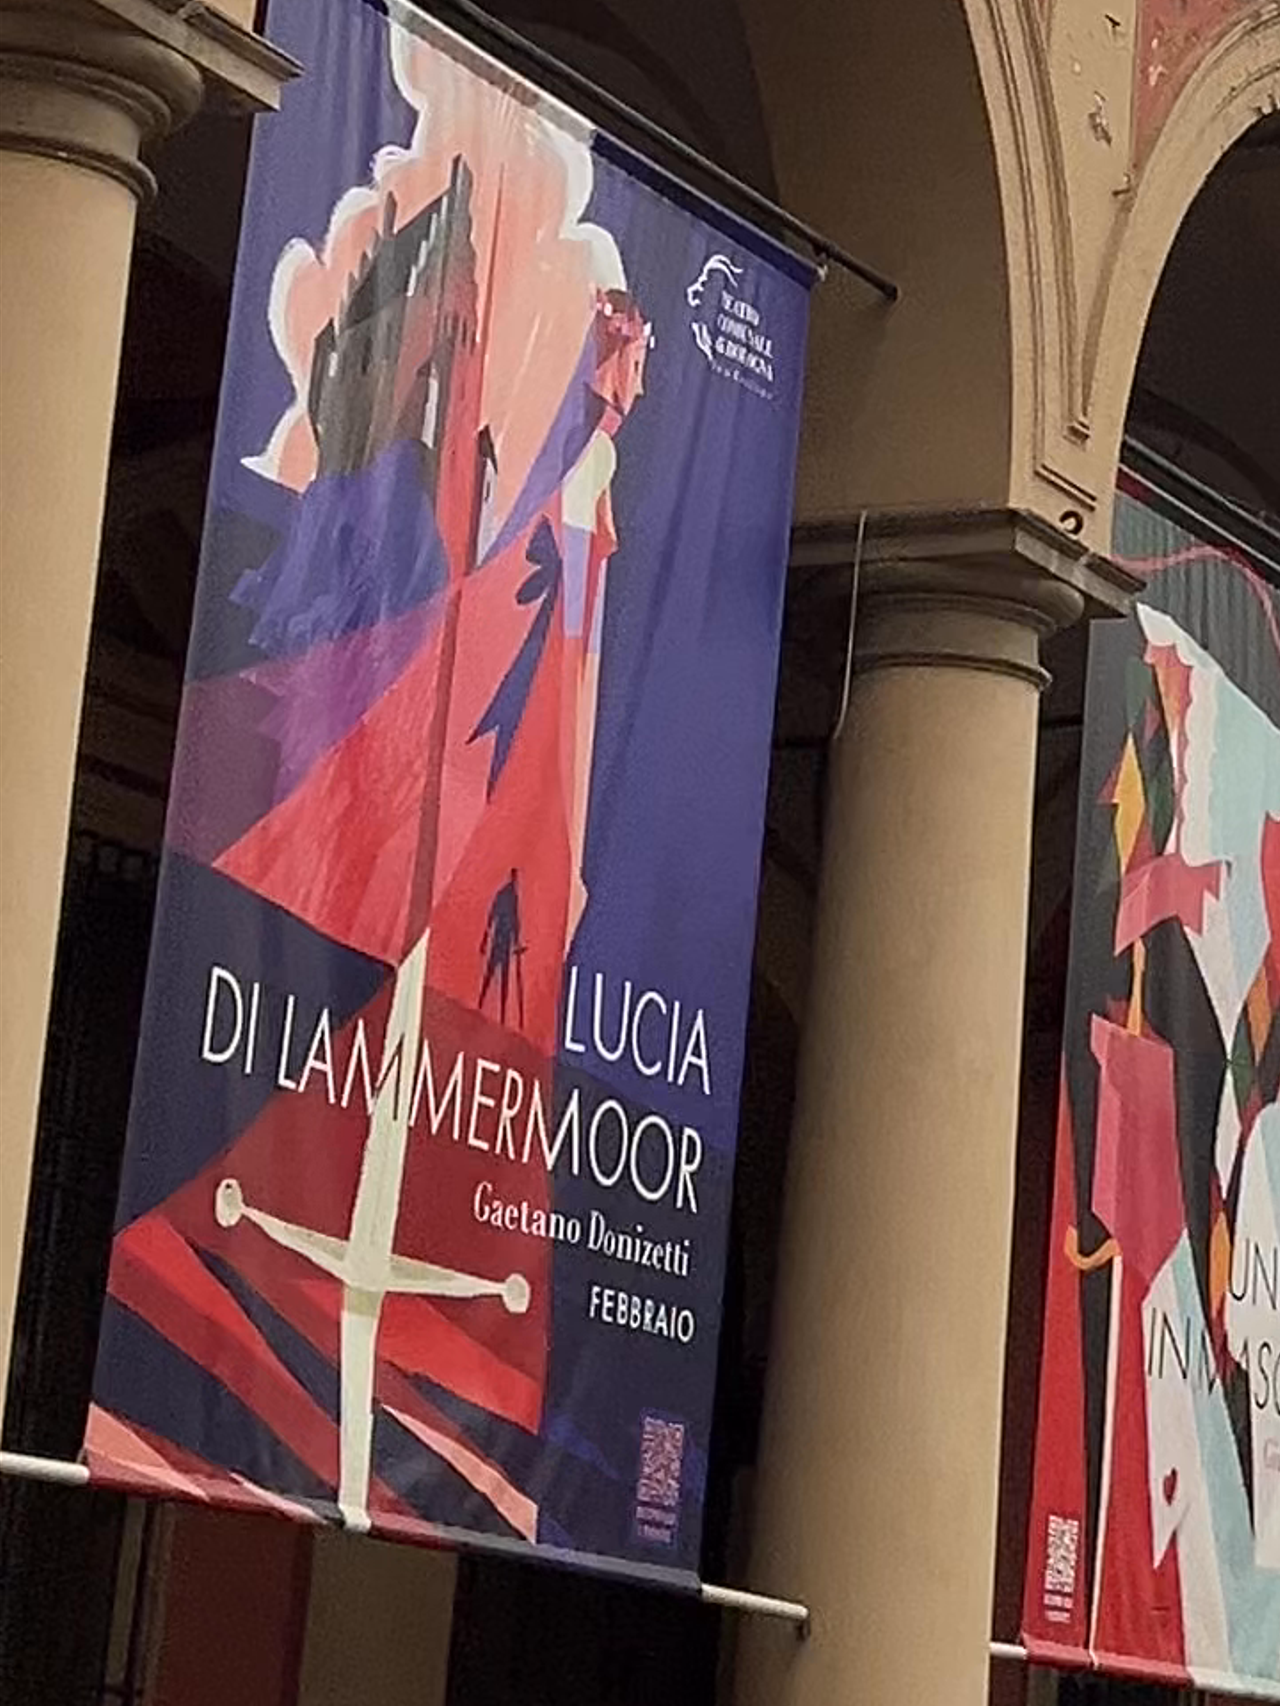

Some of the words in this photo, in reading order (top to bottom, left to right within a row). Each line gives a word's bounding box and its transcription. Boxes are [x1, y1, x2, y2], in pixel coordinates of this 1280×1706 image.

[563, 965, 711, 1095] LUCIA
[202, 965, 260, 1075] DI
[277, 994, 703, 1214] LAMMERMOOR
[473, 1181, 581, 1245] Gaetano
[587, 1209, 692, 1278] Donizetti
[588, 1285, 695, 1344] FEBBRAIO
[1230, 1237, 1277, 1311] UN
[1147, 1307, 1192, 1380] IN
